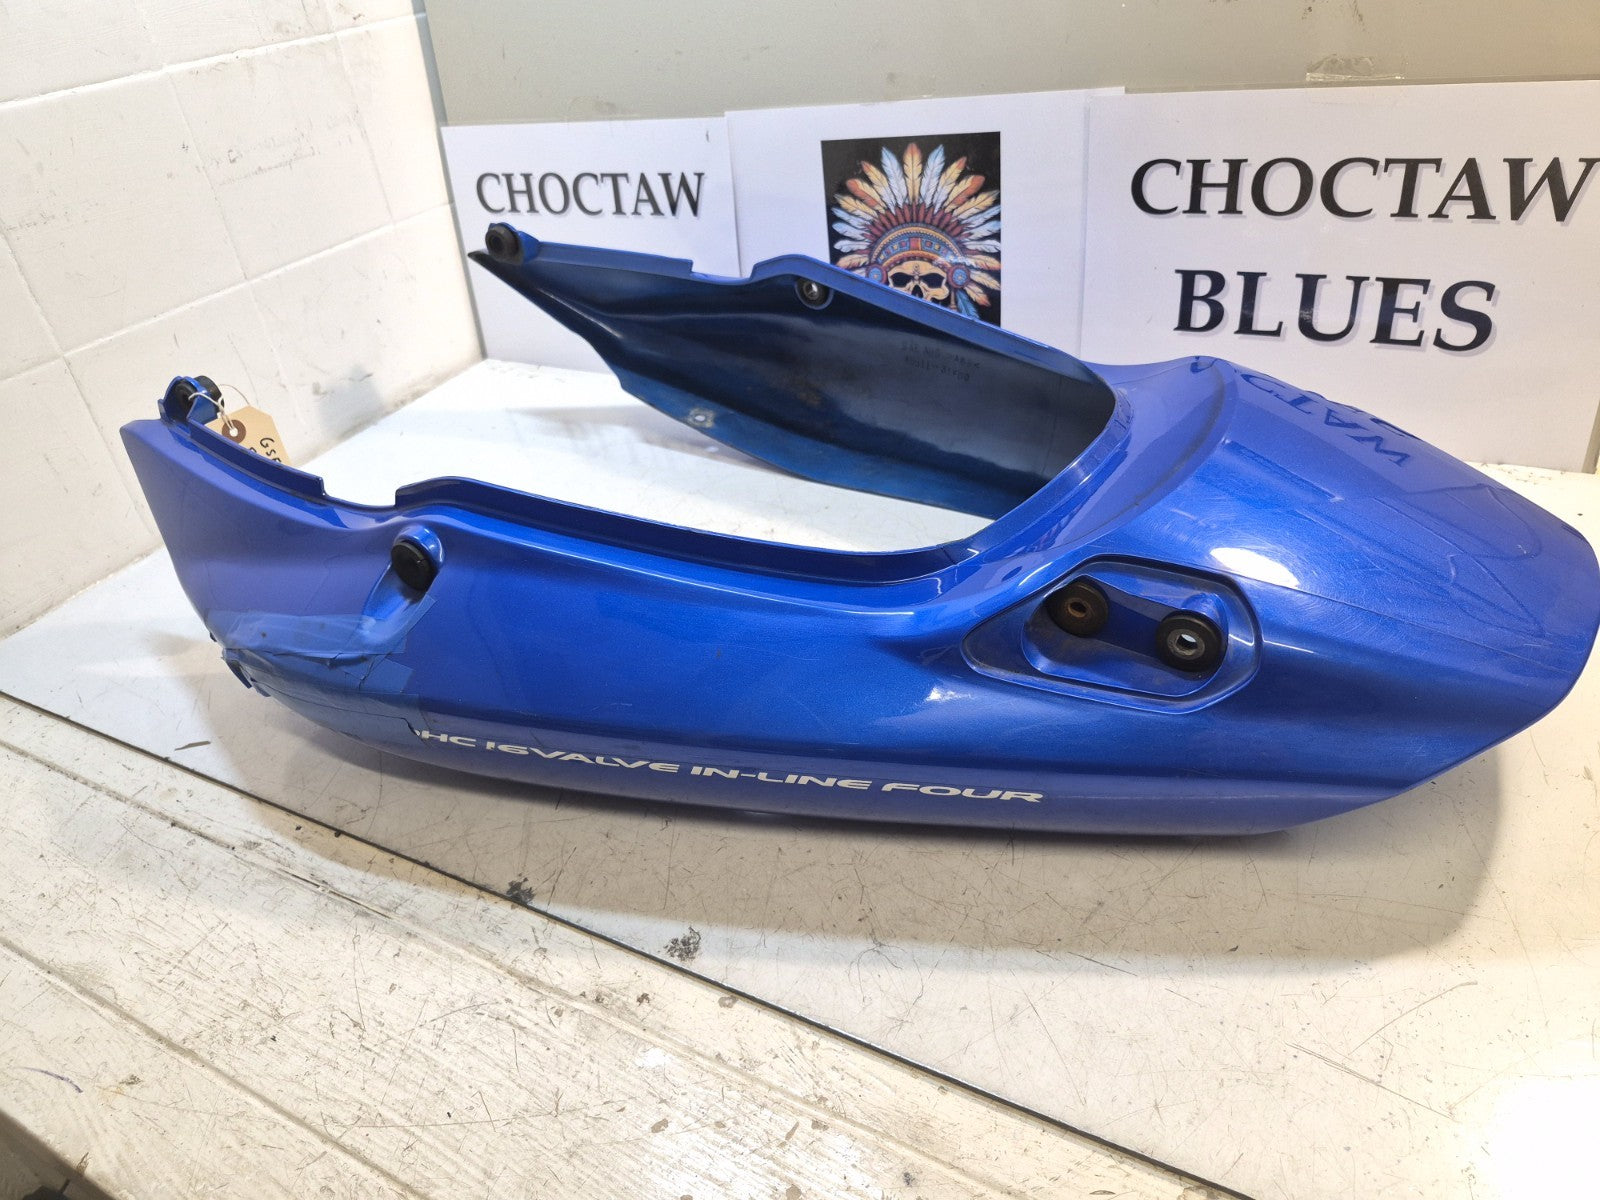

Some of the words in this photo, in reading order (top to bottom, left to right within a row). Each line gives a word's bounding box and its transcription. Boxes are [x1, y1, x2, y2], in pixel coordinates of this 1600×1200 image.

[476, 172, 705, 217] CHOCTAW
[1131, 157, 1600, 222] CHOCTAW
[1173, 269, 1496, 352] BLUES
[690, 766, 873, 789] IN-LINE
[882, 783, 1044, 803] FOUR
